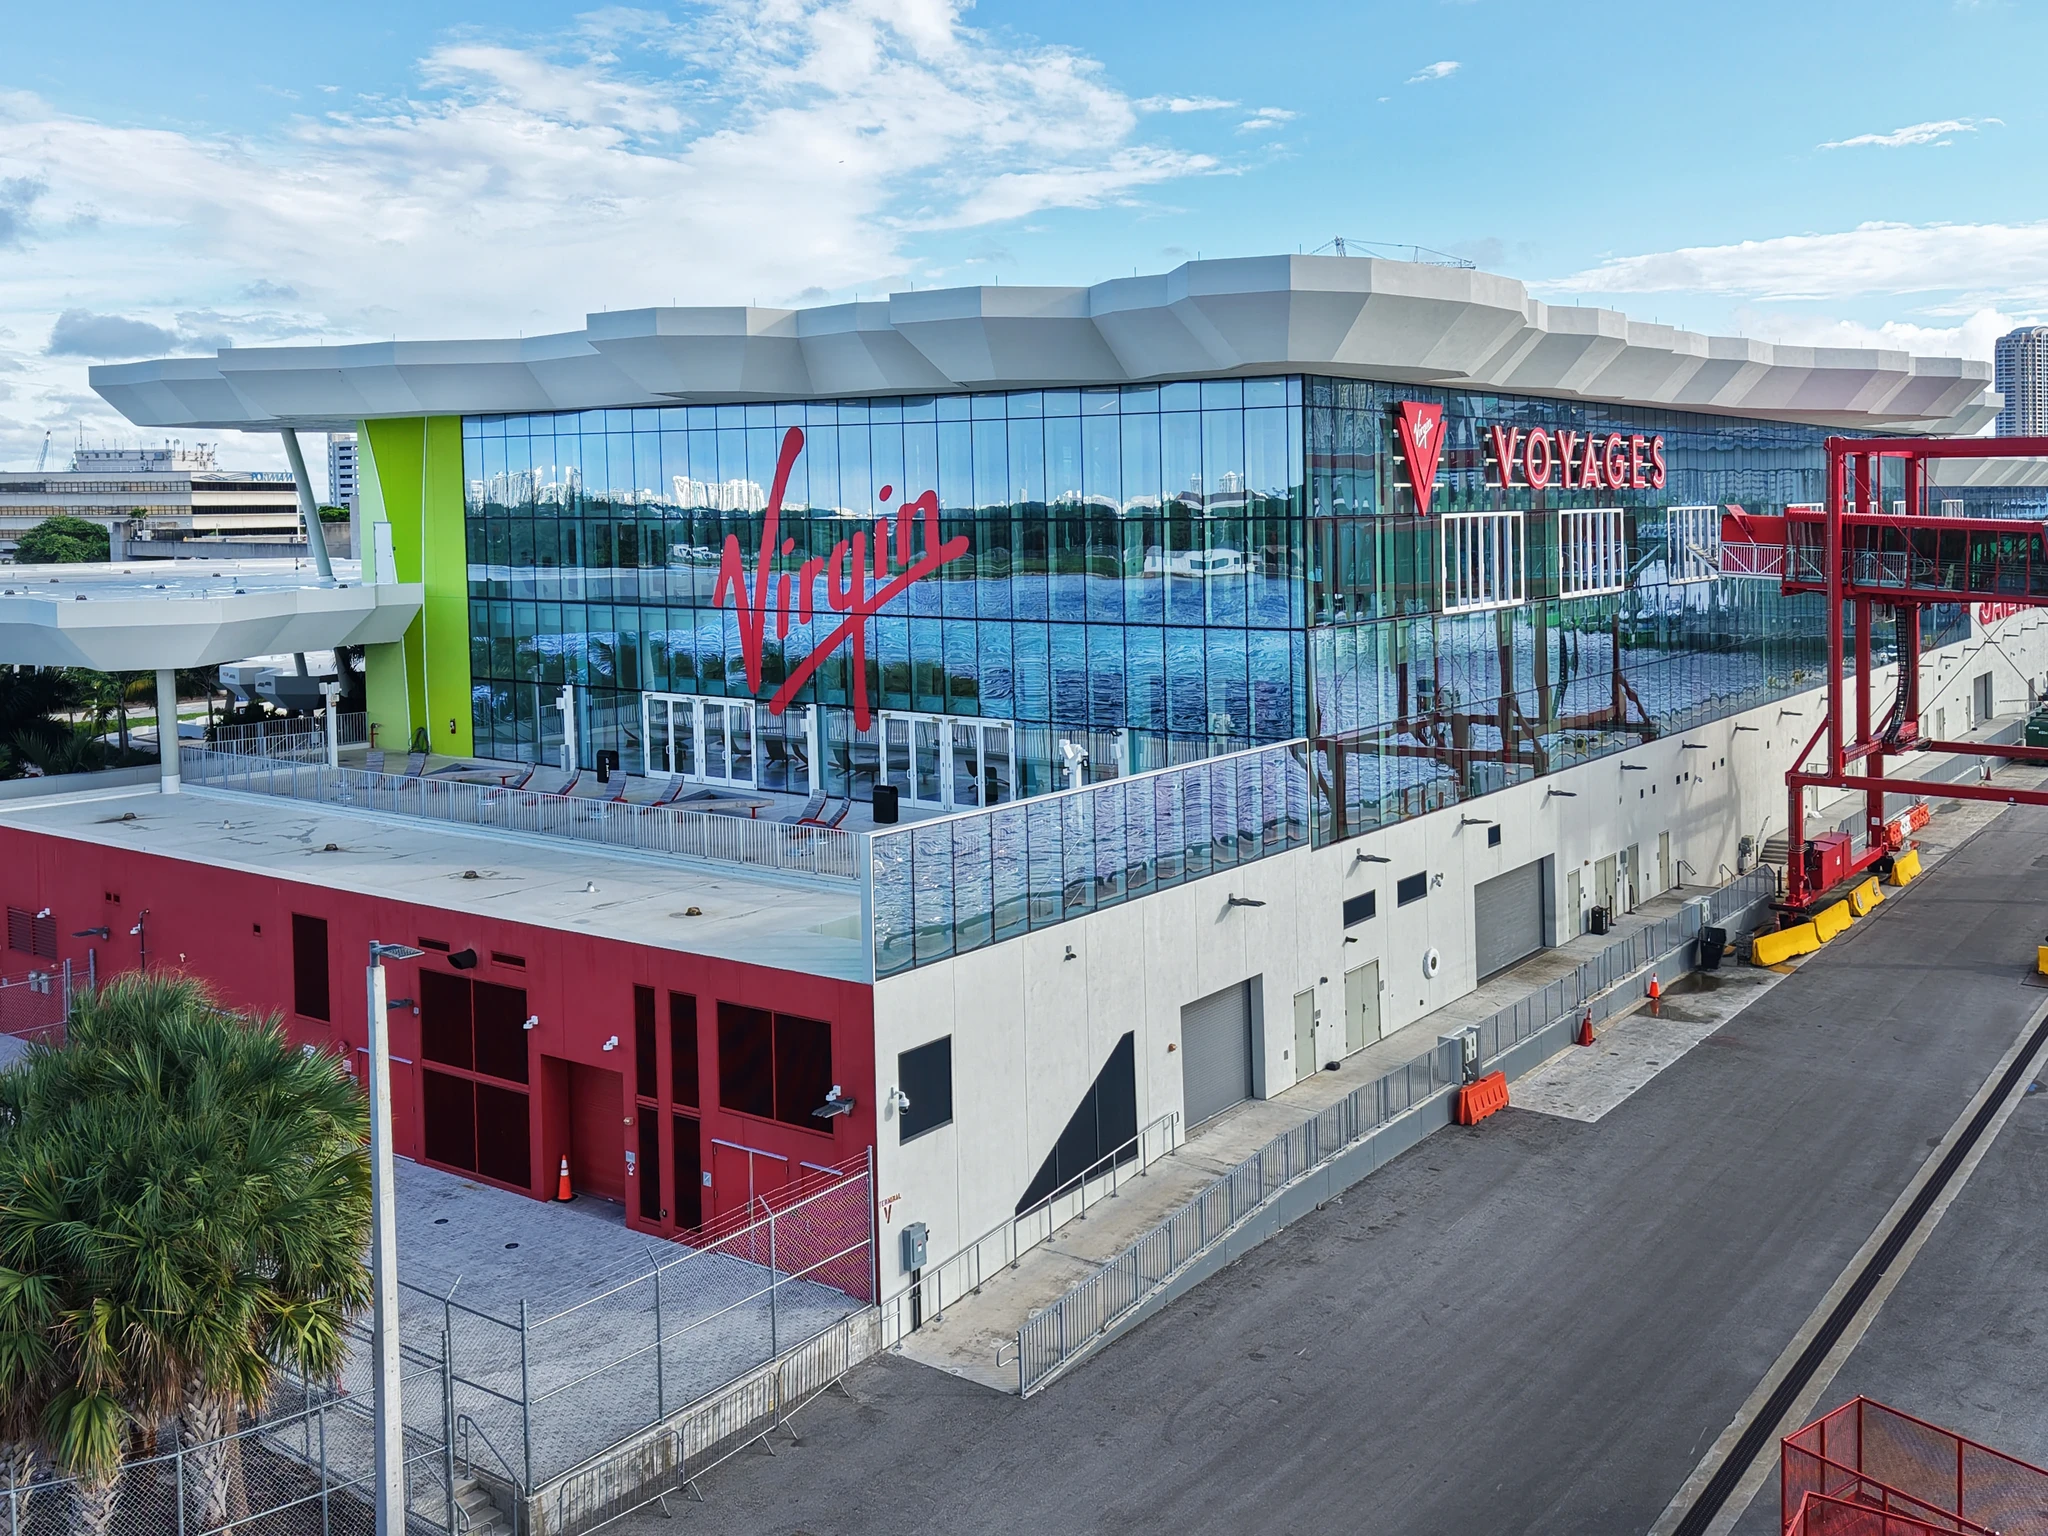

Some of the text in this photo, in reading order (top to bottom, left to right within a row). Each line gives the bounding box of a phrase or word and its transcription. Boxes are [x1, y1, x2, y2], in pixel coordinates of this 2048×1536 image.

[1413, 409, 1434, 449] Virgin
[1490, 425, 1667, 490] VOYAGES
[713, 426, 970, 732] Virgin
[884, 1204, 892, 1224] V
